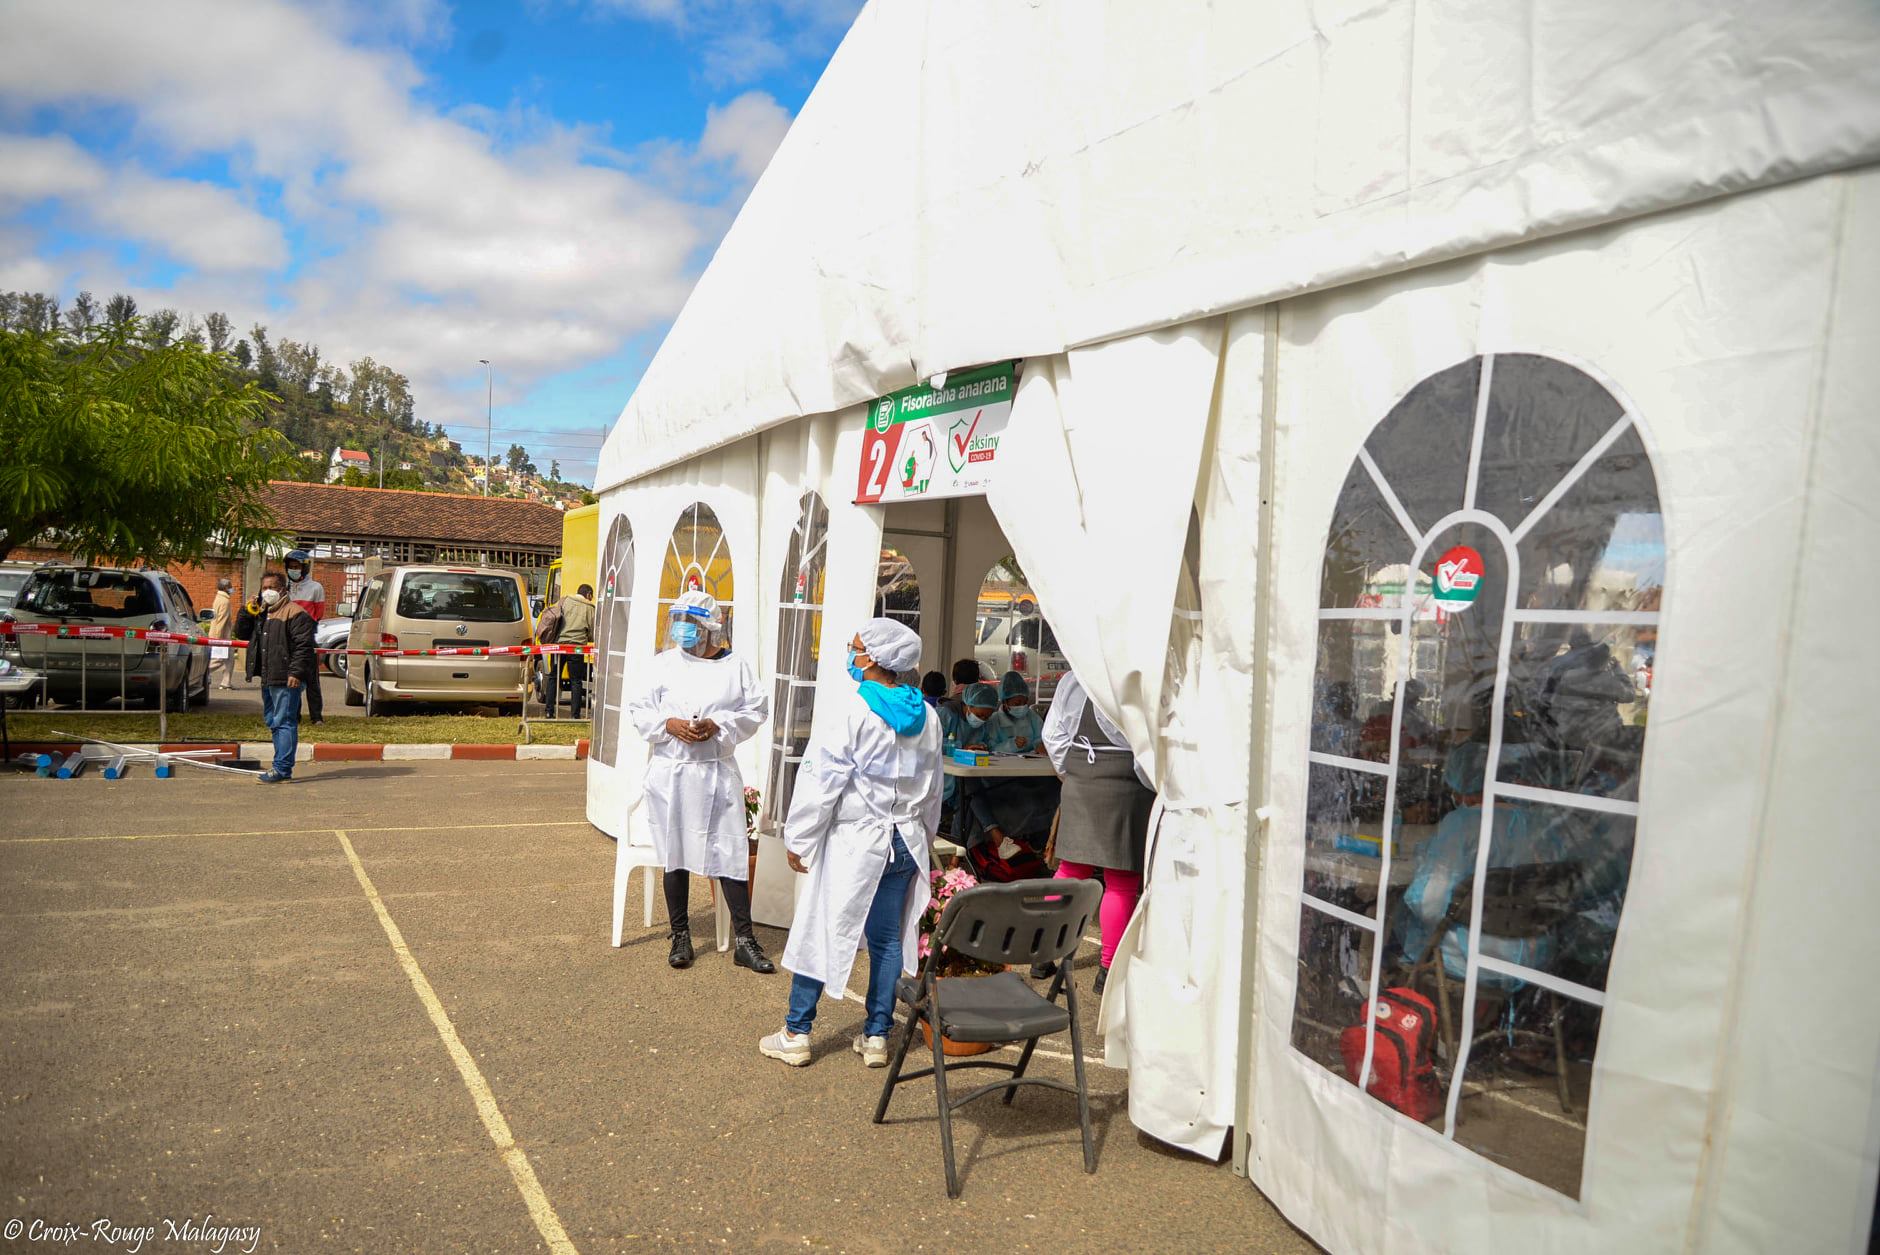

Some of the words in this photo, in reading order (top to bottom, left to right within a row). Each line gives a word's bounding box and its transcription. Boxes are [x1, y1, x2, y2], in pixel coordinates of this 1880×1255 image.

[900, 389, 956, 413] Fisoratana
[958, 375, 1007, 399] anarana
[865, 439, 888, 497] 2
